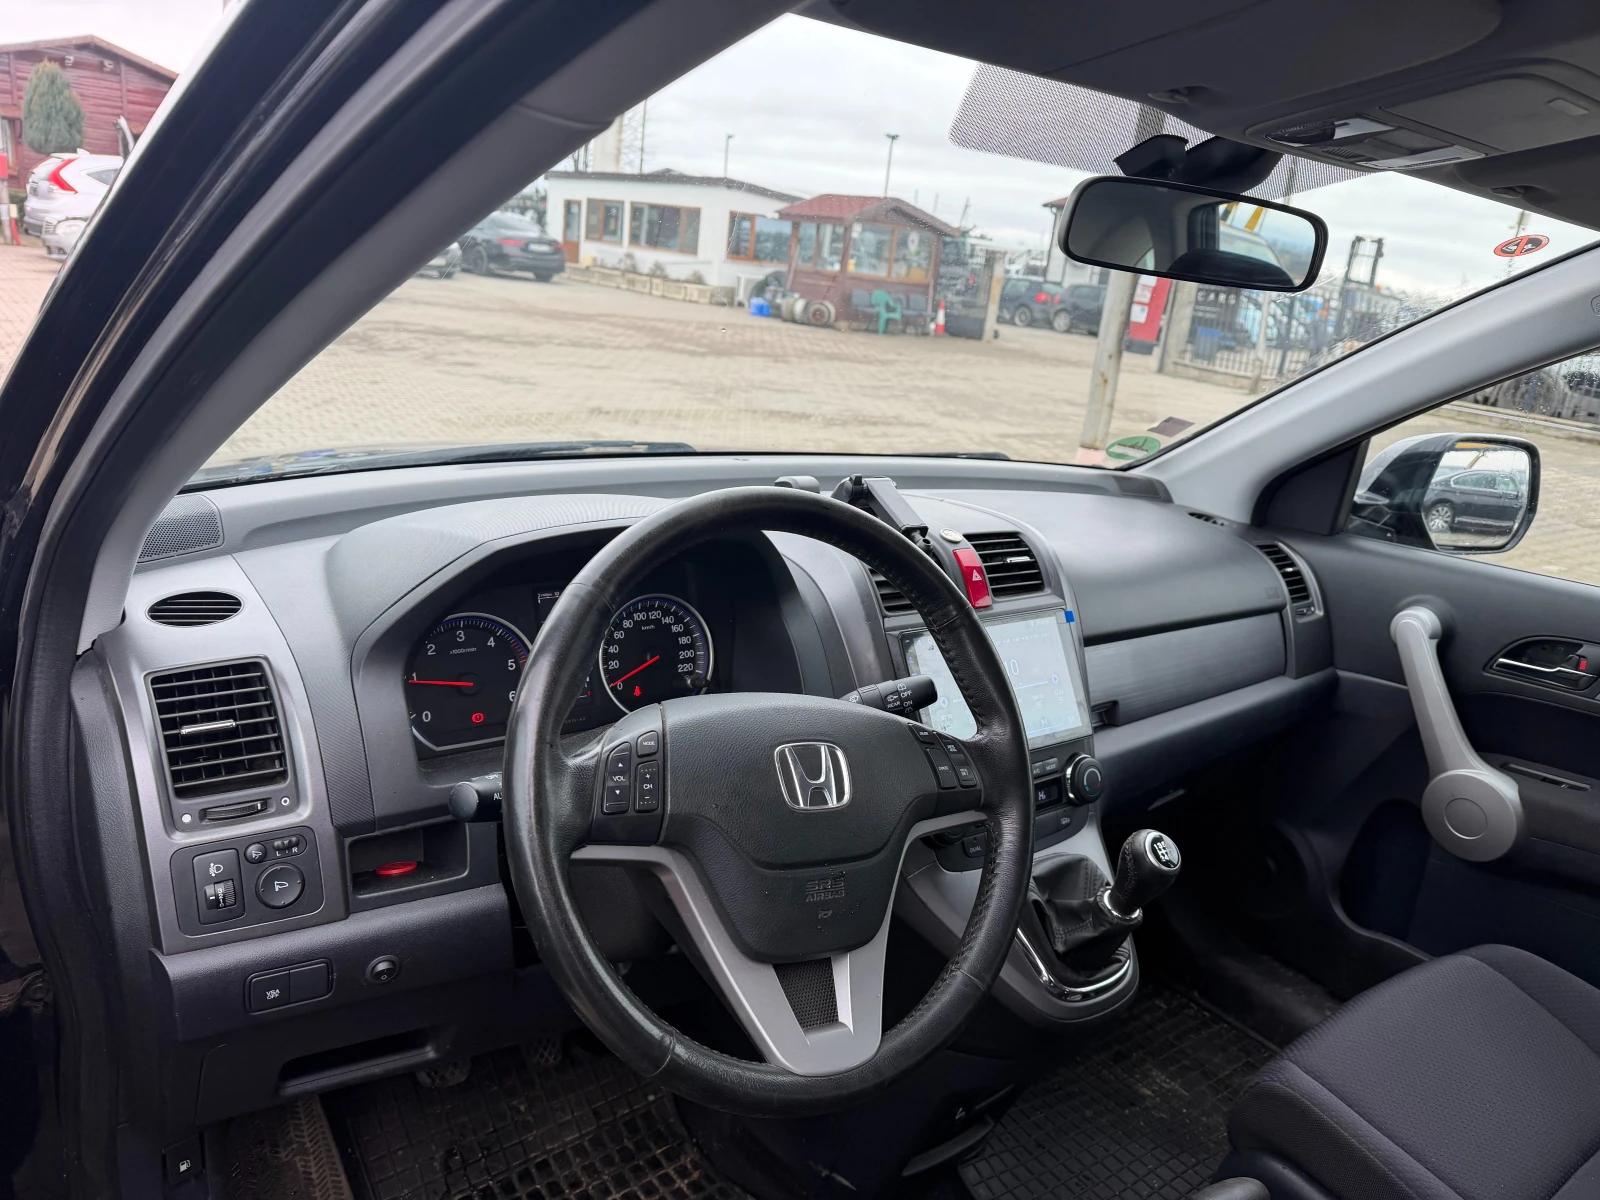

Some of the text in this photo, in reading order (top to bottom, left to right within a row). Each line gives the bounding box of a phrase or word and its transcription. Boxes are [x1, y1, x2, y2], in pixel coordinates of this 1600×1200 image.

[633, 612, 646, 621] 100
[648, 610, 662, 619] 120
[622, 619, 633, 629] 80
[661, 615, 674, 625] 140
[671, 623, 684, 633] 160
[456, 630, 465, 642] 3
[613, 630, 625, 640] 60
[678, 635, 691, 645] 180
[487, 636, 496, 648] 4
[427, 643, 436, 656] 2
[608, 645, 619, 654] 40
[679, 649, 694, 660] 200
[507, 659, 516, 671] 5
[608, 660, 619, 670] 20
[678, 665, 693, 673] 220
[411, 671, 417, 681] 1
[617, 682, 623, 691] 0
[508, 690, 516, 702] 6
[900, 689, 913, 699] OFF
[887, 701, 901, 709] REAR
[903, 700, 913, 708] ON
[422, 710, 432, 723] 0
[969, 845, 982, 853] DUAL
[805, 879, 844, 890] SRS
